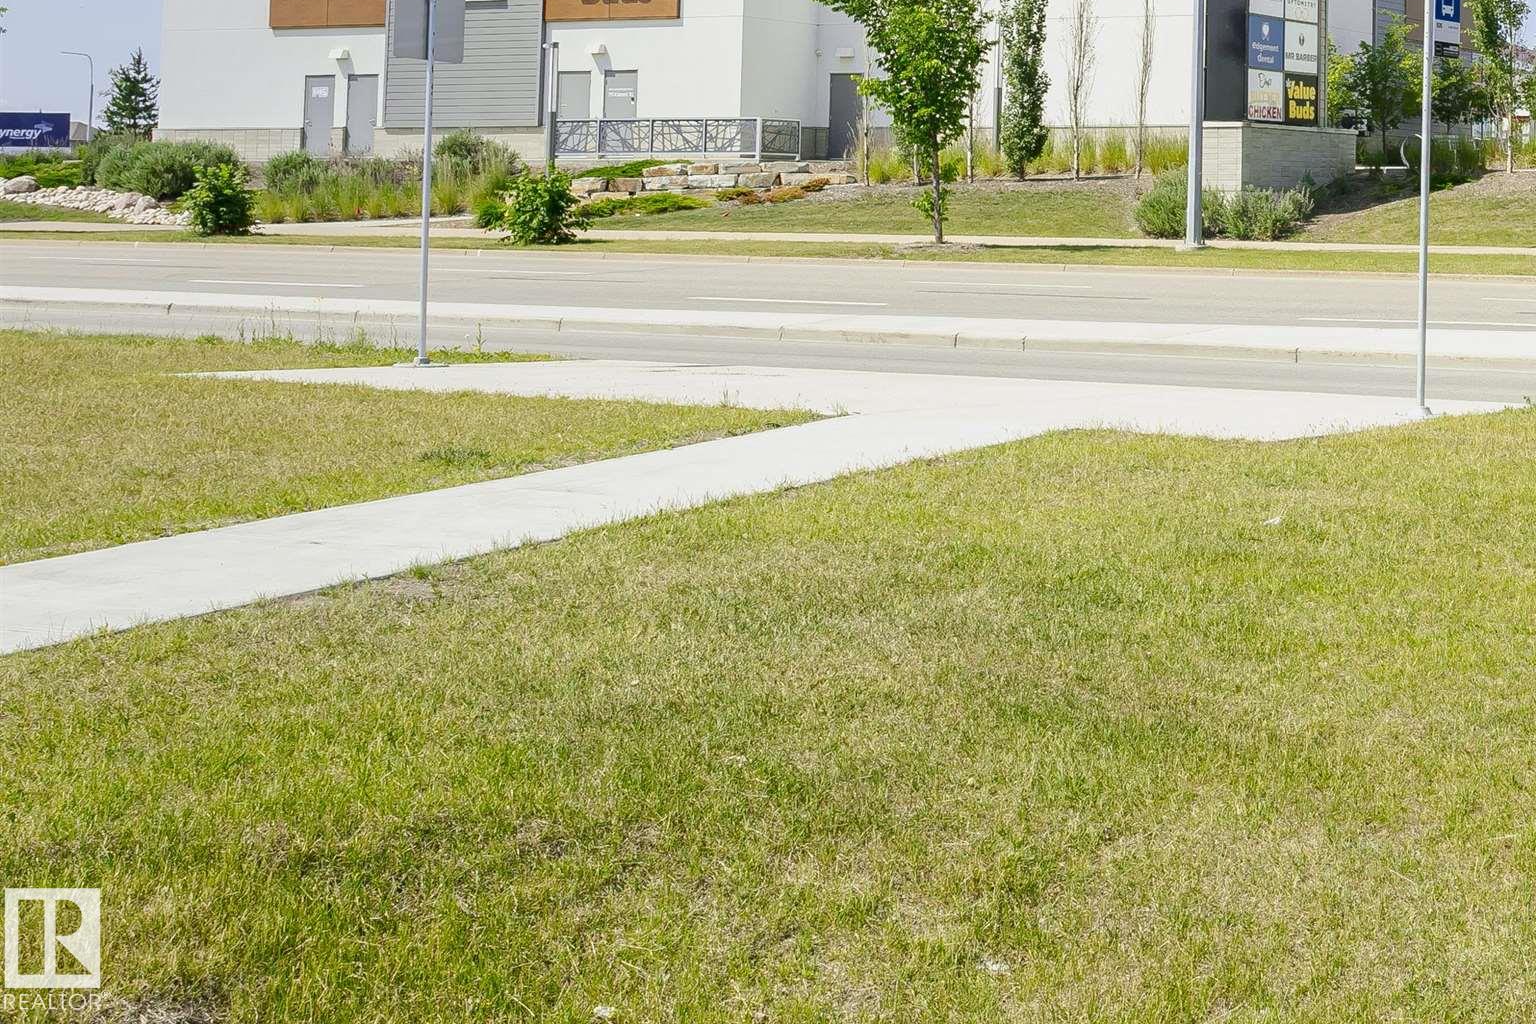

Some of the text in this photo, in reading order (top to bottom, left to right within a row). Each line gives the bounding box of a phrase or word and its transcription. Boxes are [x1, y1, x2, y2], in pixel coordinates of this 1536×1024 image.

[1287, 79, 1317, 100] Value
[1248, 104, 1282, 119] CHICKEN
[1289, 100, 1316, 120] Buds
